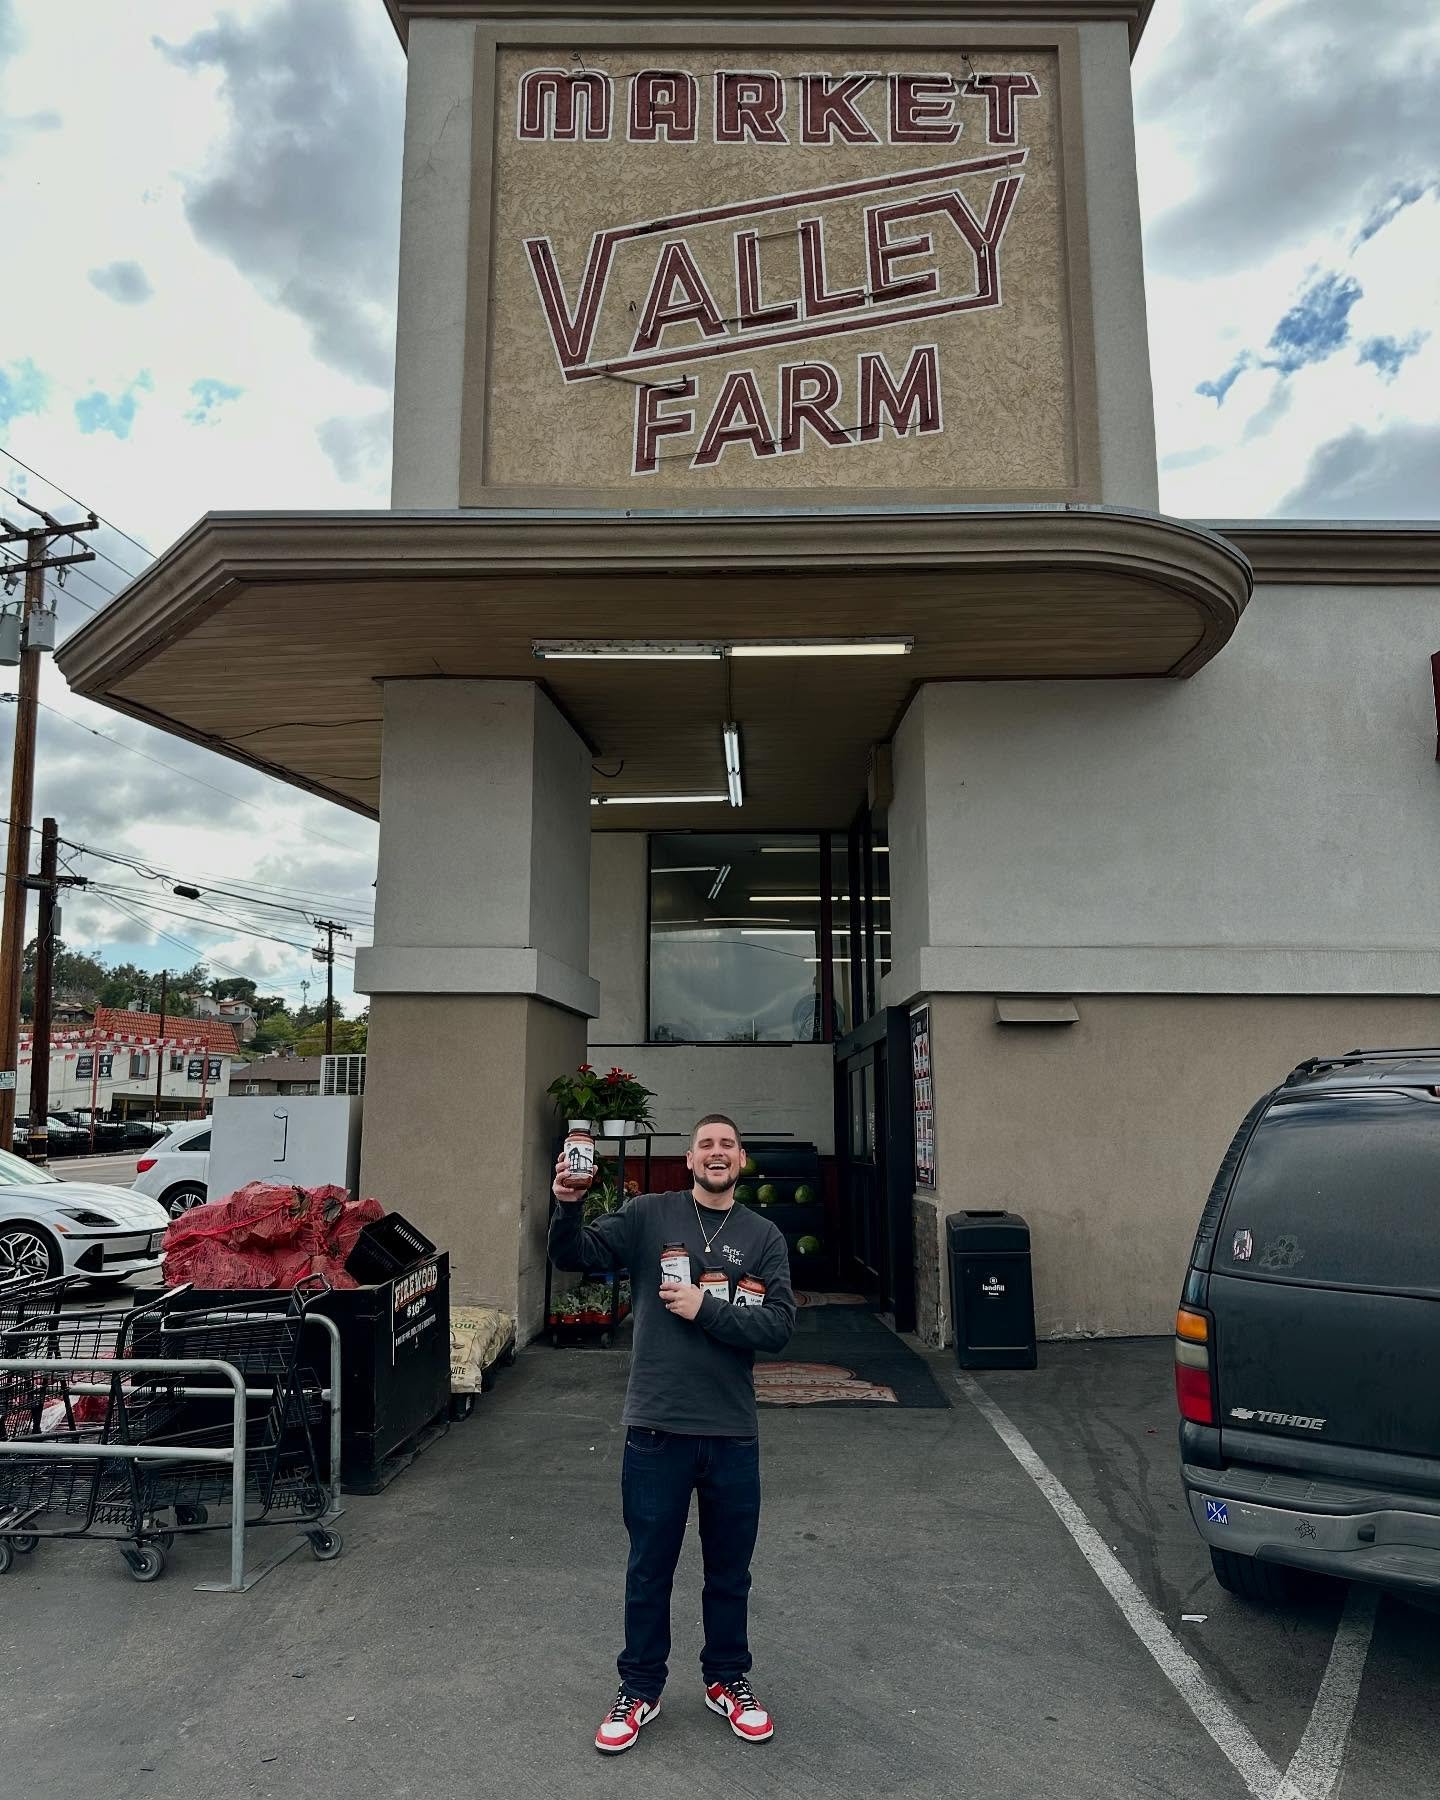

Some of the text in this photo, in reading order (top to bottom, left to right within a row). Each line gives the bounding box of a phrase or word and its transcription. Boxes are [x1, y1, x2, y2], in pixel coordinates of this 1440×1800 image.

[517, 67, 1042, 146] MARKET
[522, 172, 1027, 384] VALLEY
[630, 343, 944, 477] FARM
[394, 1264, 438, 1312] FIREWOOD
[982, 1283, 1005, 1292] landfill
[1256, 1410, 1327, 1431] TAHOE
